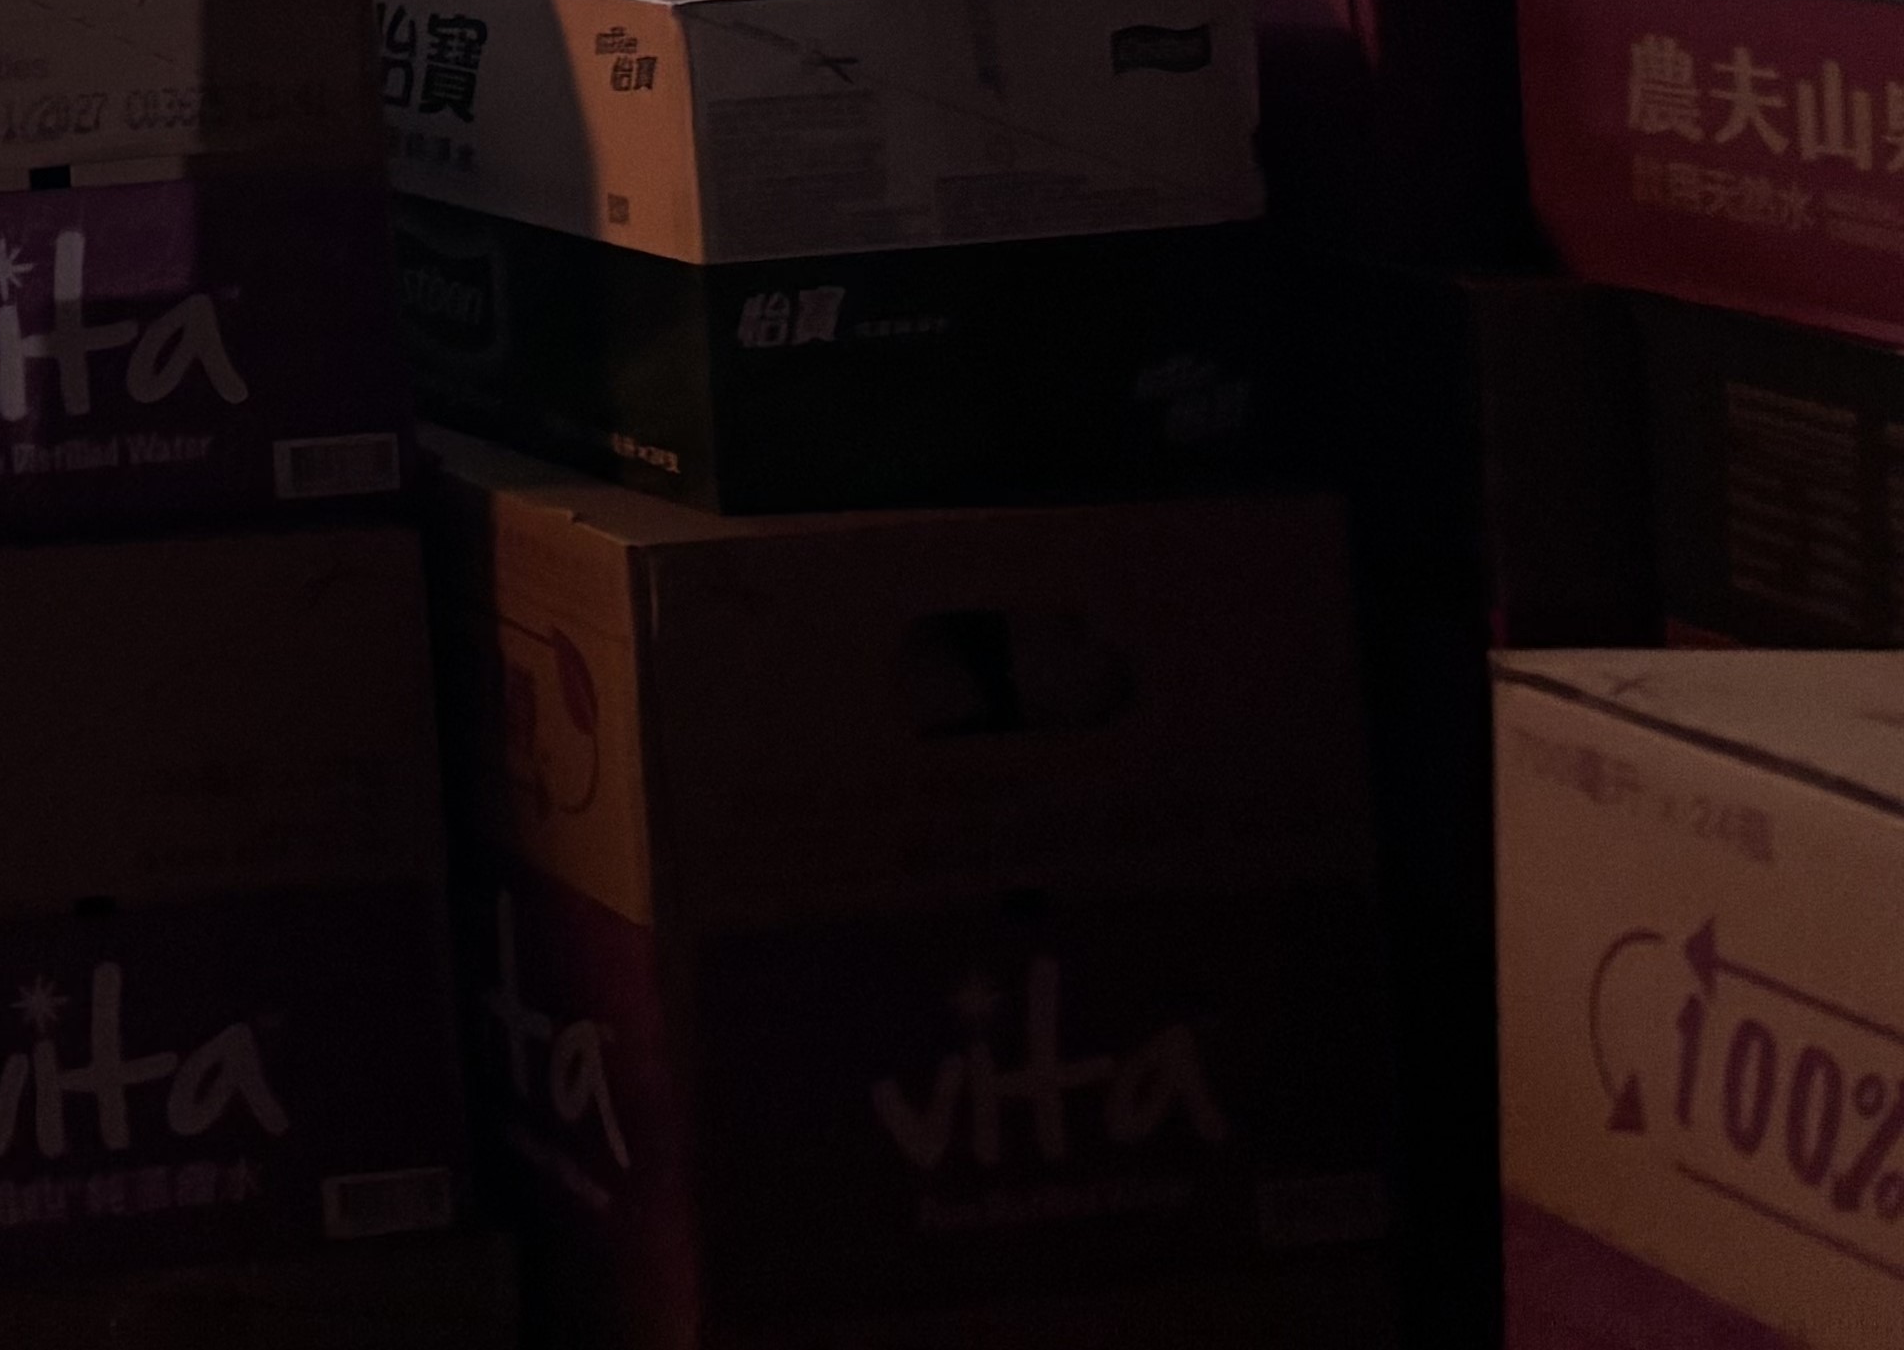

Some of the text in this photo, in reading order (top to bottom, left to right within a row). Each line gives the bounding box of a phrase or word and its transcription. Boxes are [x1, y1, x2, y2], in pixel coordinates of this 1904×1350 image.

[1628, 33, 1904, 173] 農夫山
[481, 887, 631, 1170] ta
[869, 954, 1229, 1171] vita
